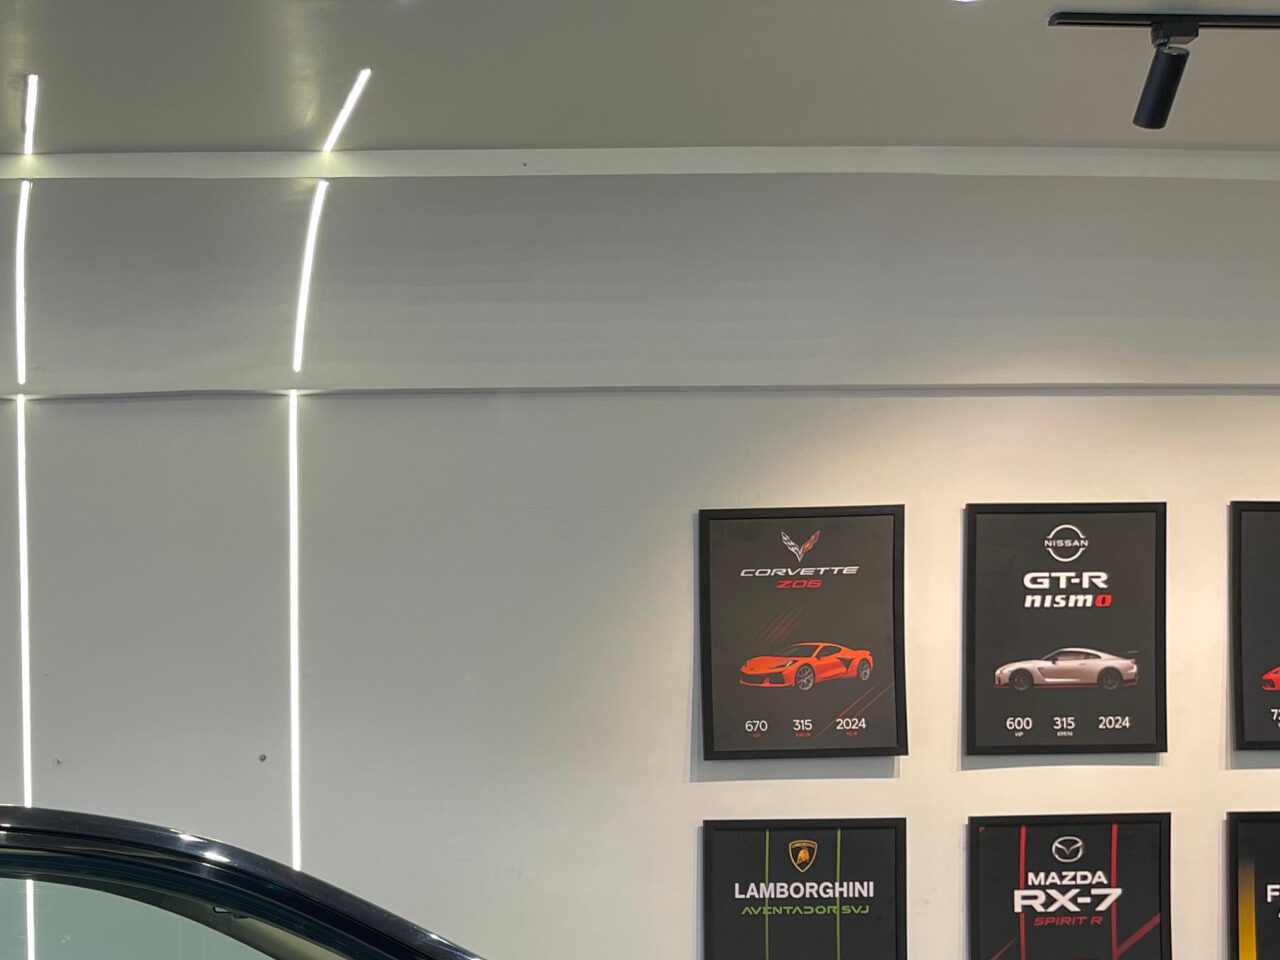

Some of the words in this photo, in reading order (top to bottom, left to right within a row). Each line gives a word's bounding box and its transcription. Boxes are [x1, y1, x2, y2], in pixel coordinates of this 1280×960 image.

[740, 566, 860, 577] CORVETTE
[776, 580, 822, 589] Z06
[1023, 572, 1108, 589] GT-R
[1270, 708, 1280, 720] 7
[745, 720, 768, 732] 670
[793, 719, 813, 731] 315
[835, 718, 866, 730] 2024
[1006, 717, 1033, 730] 600
[1053, 716, 1075, 729] 315
[1098, 716, 1130, 729] 2024
[1027, 871, 1108, 886] MAZDA
[734, 881, 874, 899] LAMBORGHINI
[1014, 888, 1123, 913] RX-7
[741, 905, 838, 915] AVENTADOR
[841, 905, 870, 914] SVJ
[1033, 916, 1087, 926] SPIRIT
[1090, 916, 1103, 925] R
